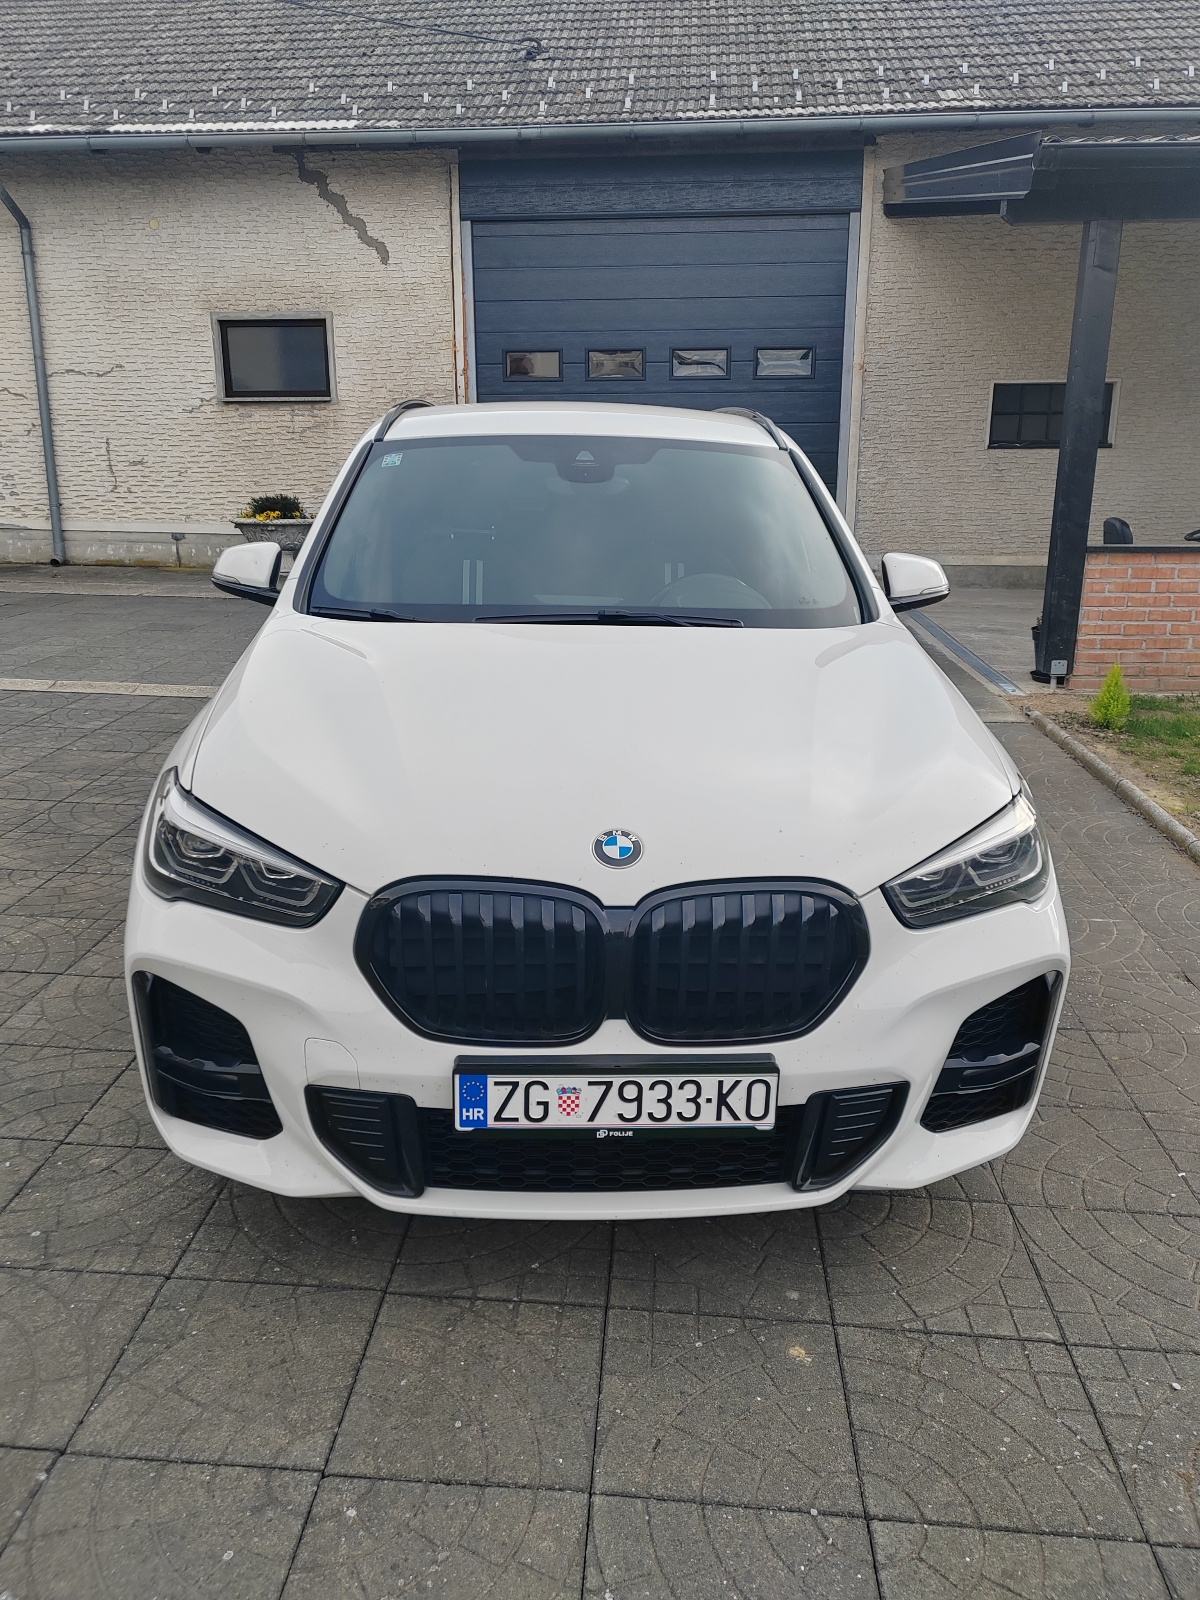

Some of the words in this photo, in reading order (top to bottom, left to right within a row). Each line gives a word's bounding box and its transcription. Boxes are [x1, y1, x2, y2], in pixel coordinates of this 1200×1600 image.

[597, 830, 638, 841] BMW
[493, 1080, 550, 1123] ZG
[462, 1108, 484, 1121] HR
